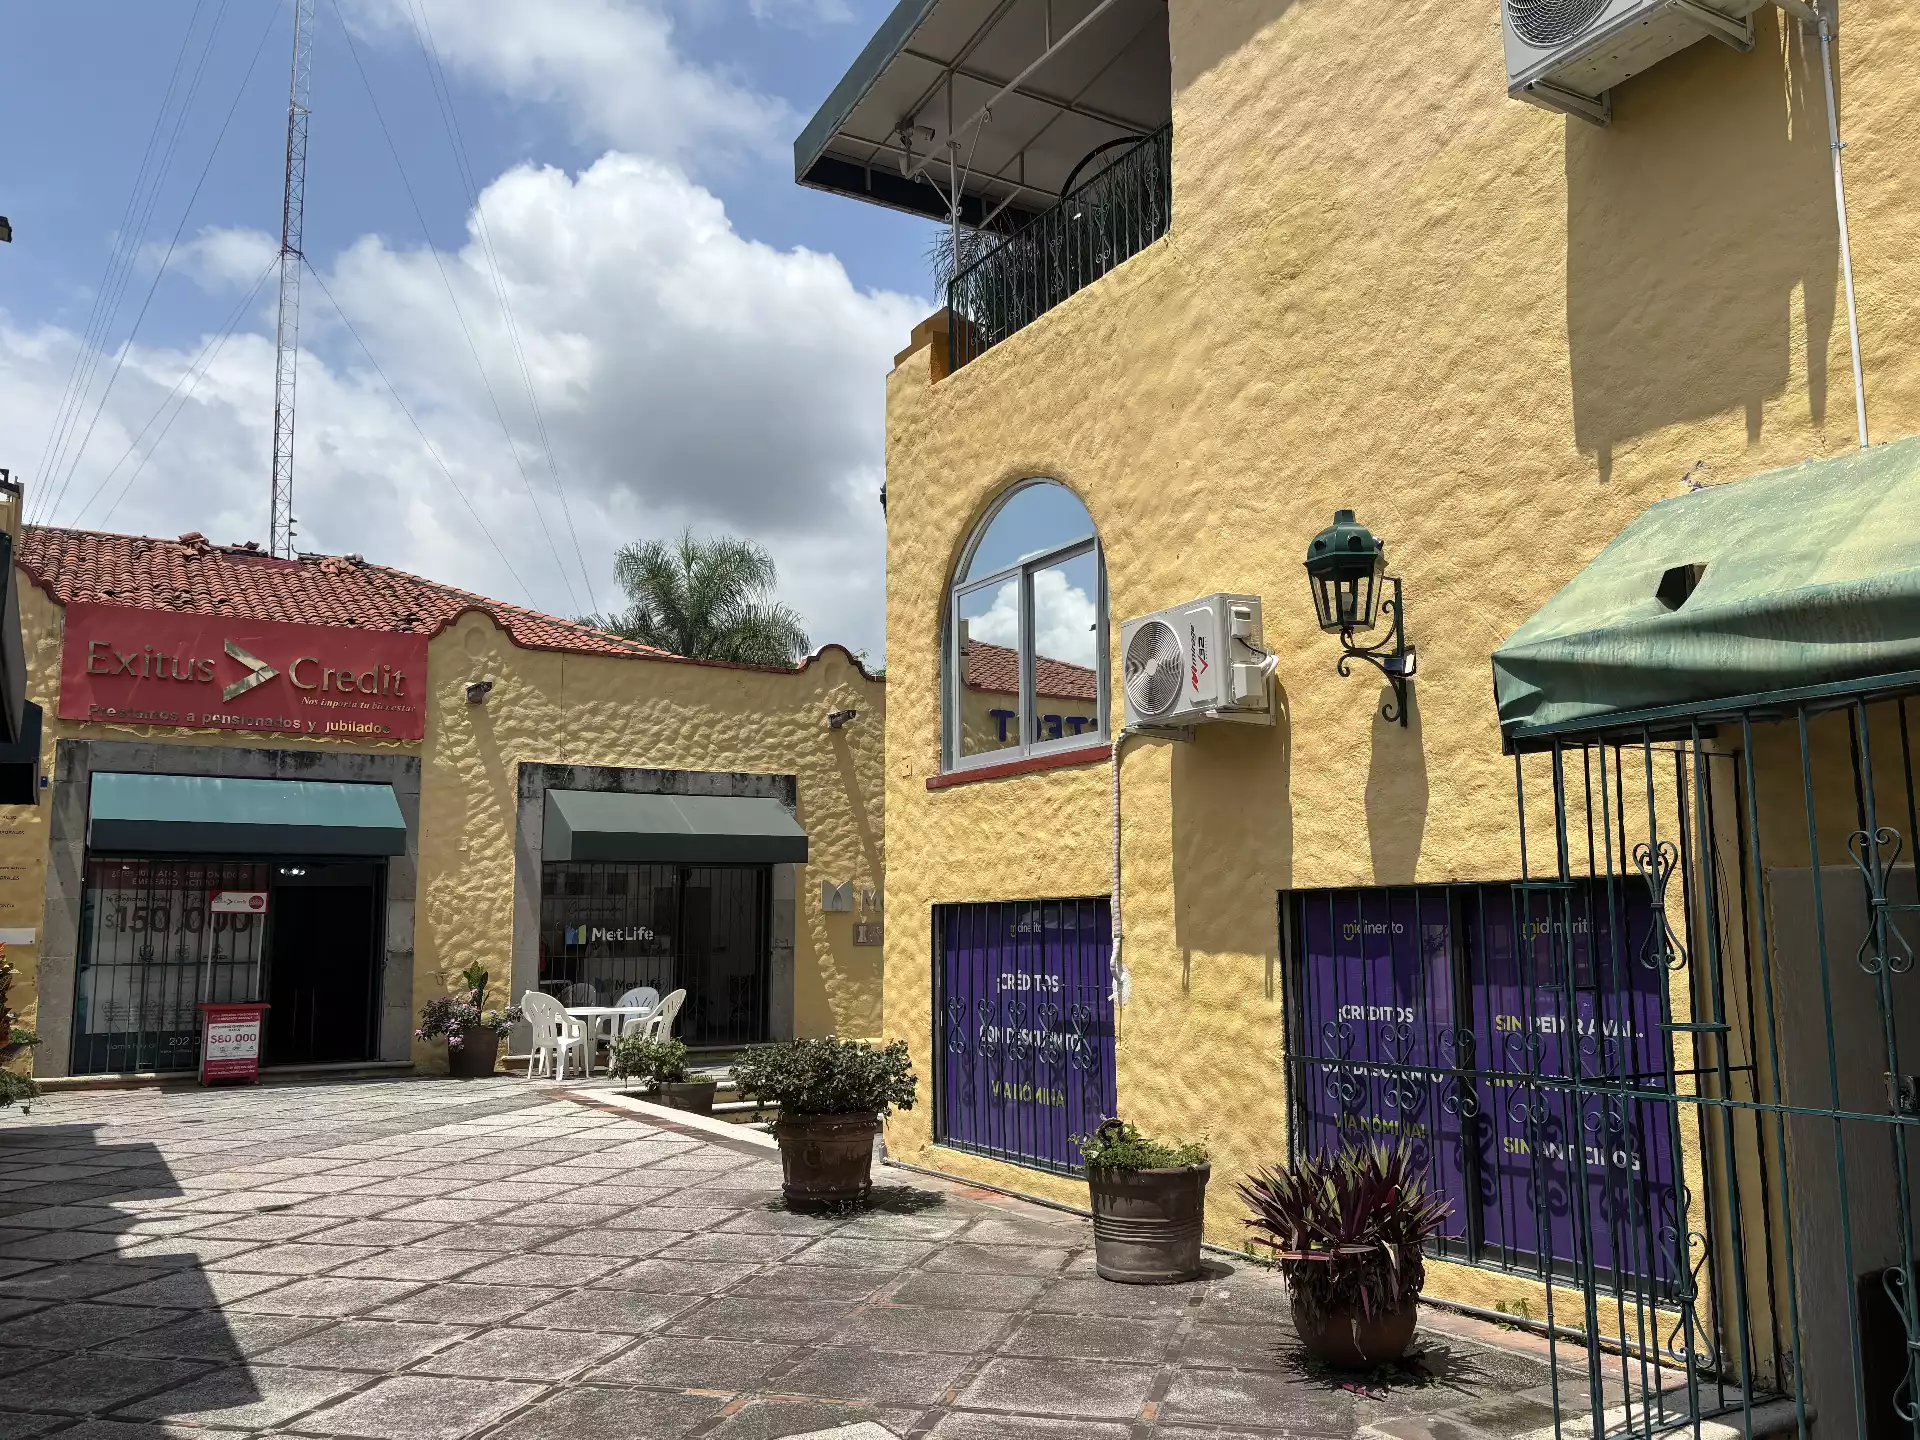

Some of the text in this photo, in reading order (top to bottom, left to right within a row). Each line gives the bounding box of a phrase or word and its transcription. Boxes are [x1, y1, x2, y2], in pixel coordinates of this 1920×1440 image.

[86, 640, 406, 697] Exitus Credit
[301, 696, 318, 706] Nos
[320, 698, 357, 709] importa
[360, 701, 371, 709] tu
[186, 711, 195, 722] a
[202, 712, 301, 730] pensionados
[308, 720, 317, 733] y
[324, 719, 391, 735] jubilados
[591, 927, 654, 942] MetLife
[1522, 917, 1594, 935] midnrit
[996, 969, 1060, 994] ¡CRÉDTOS
[1495, 1014, 1523, 1032] SIN
[1529, 1015, 1585, 1035] PEDR
[210, 1033, 257, 1044] $80,000
[1503, 1136, 1641, 1171] SIN ANTCIOS
